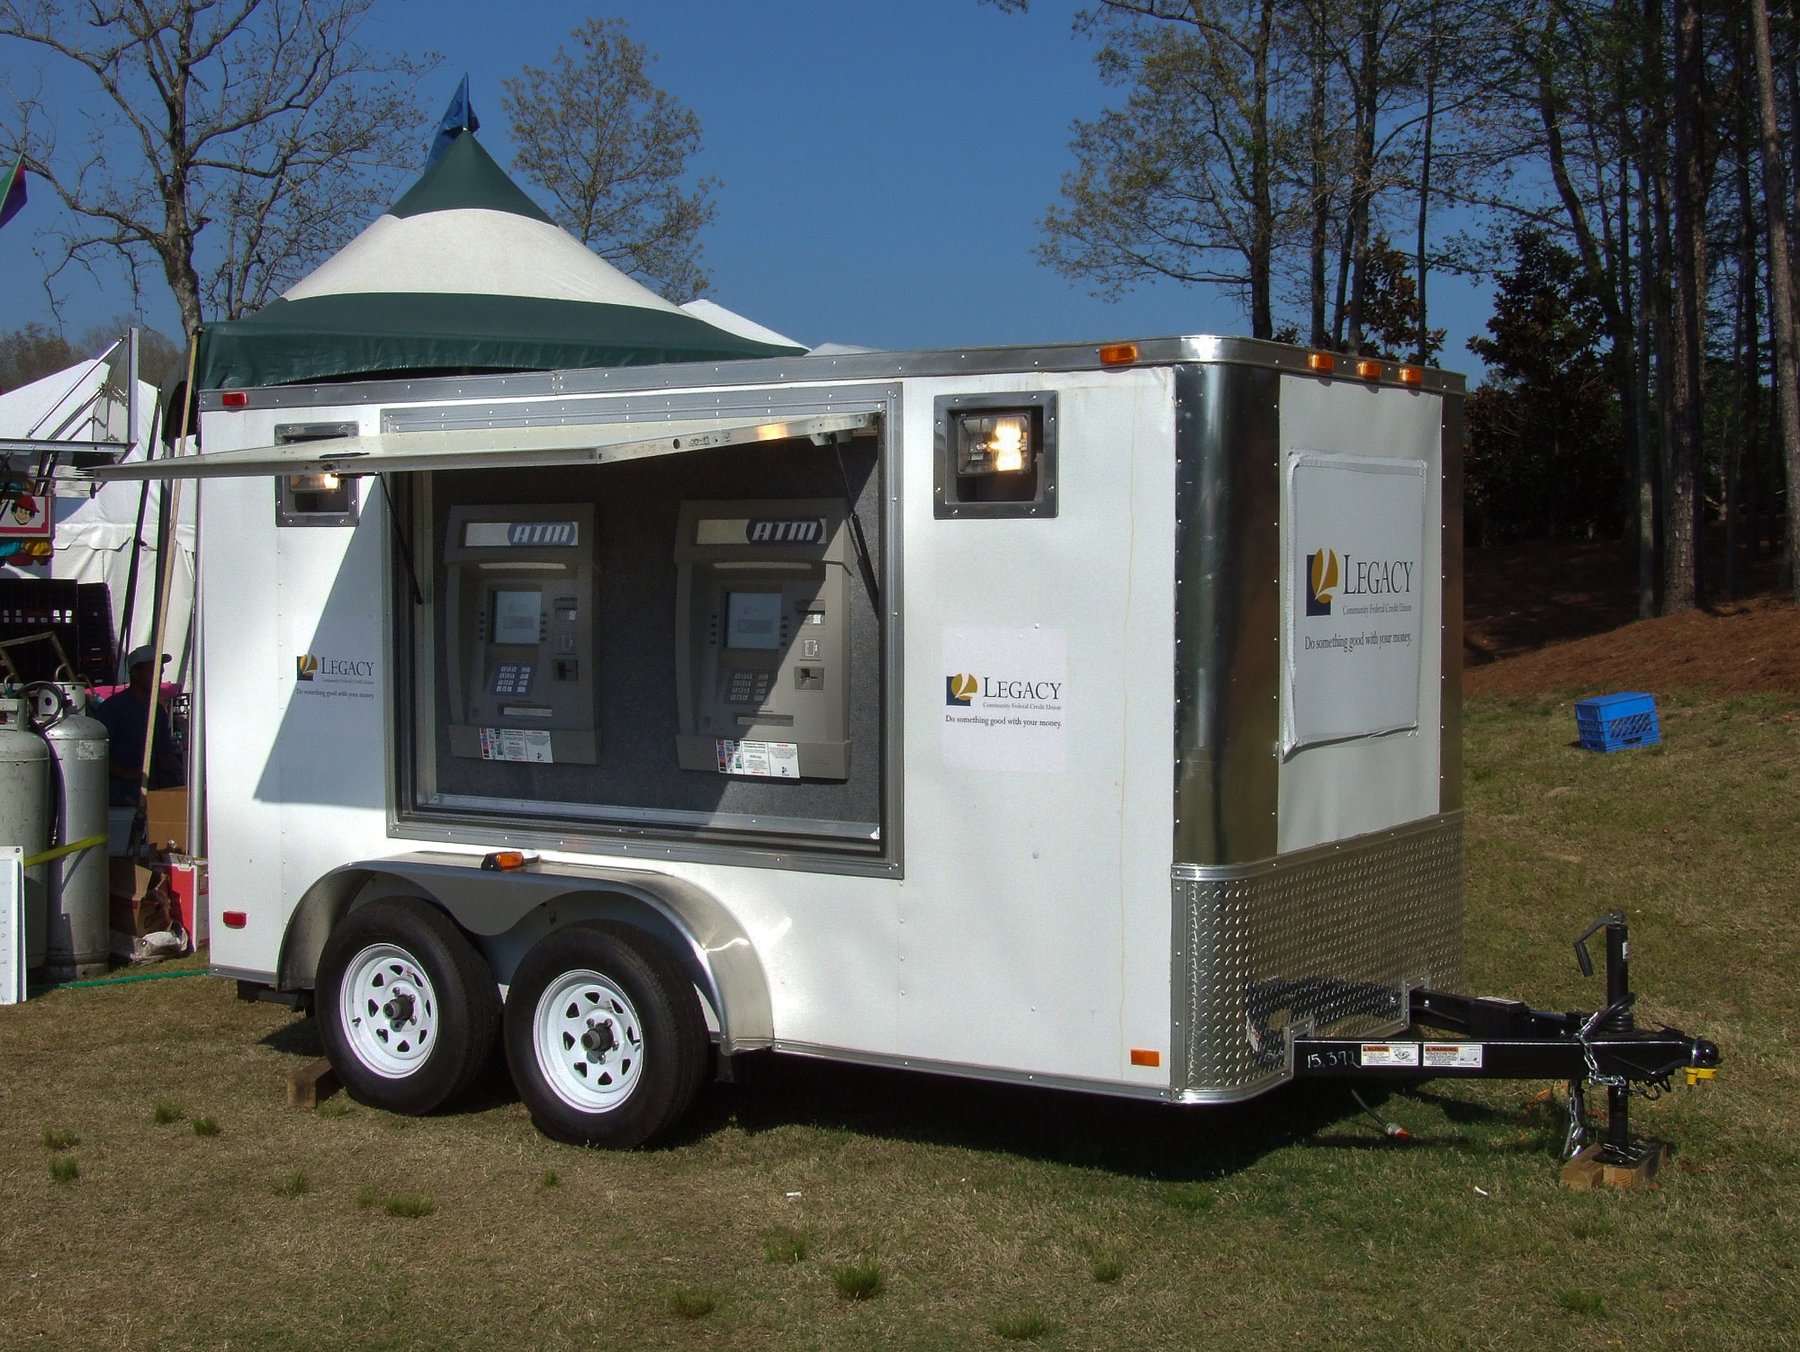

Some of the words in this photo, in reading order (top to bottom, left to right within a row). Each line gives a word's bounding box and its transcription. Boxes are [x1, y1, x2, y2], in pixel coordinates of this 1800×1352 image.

[512, 525, 571, 543] ATM
[751, 522, 818, 541] ATM
[1343, 555, 1413, 595] LEGACY
[1304, 636, 1314, 650] Do
[1316, 633, 1348, 653] something
[1349, 632, 1364, 652] good
[1365, 631, 1378, 645] with
[1379, 635, 1392, 650] your
[321, 657, 374, 676] LEGACY
[983, 677, 1062, 700] LEGACY
[945, 715, 955, 723] Do
[956, 716, 989, 727] something
[990, 717, 1006, 727] good
[1007, 717, 1022, 726] with
[1022, 720, 1038, 729] your
[1039, 720, 1063, 729] money.
